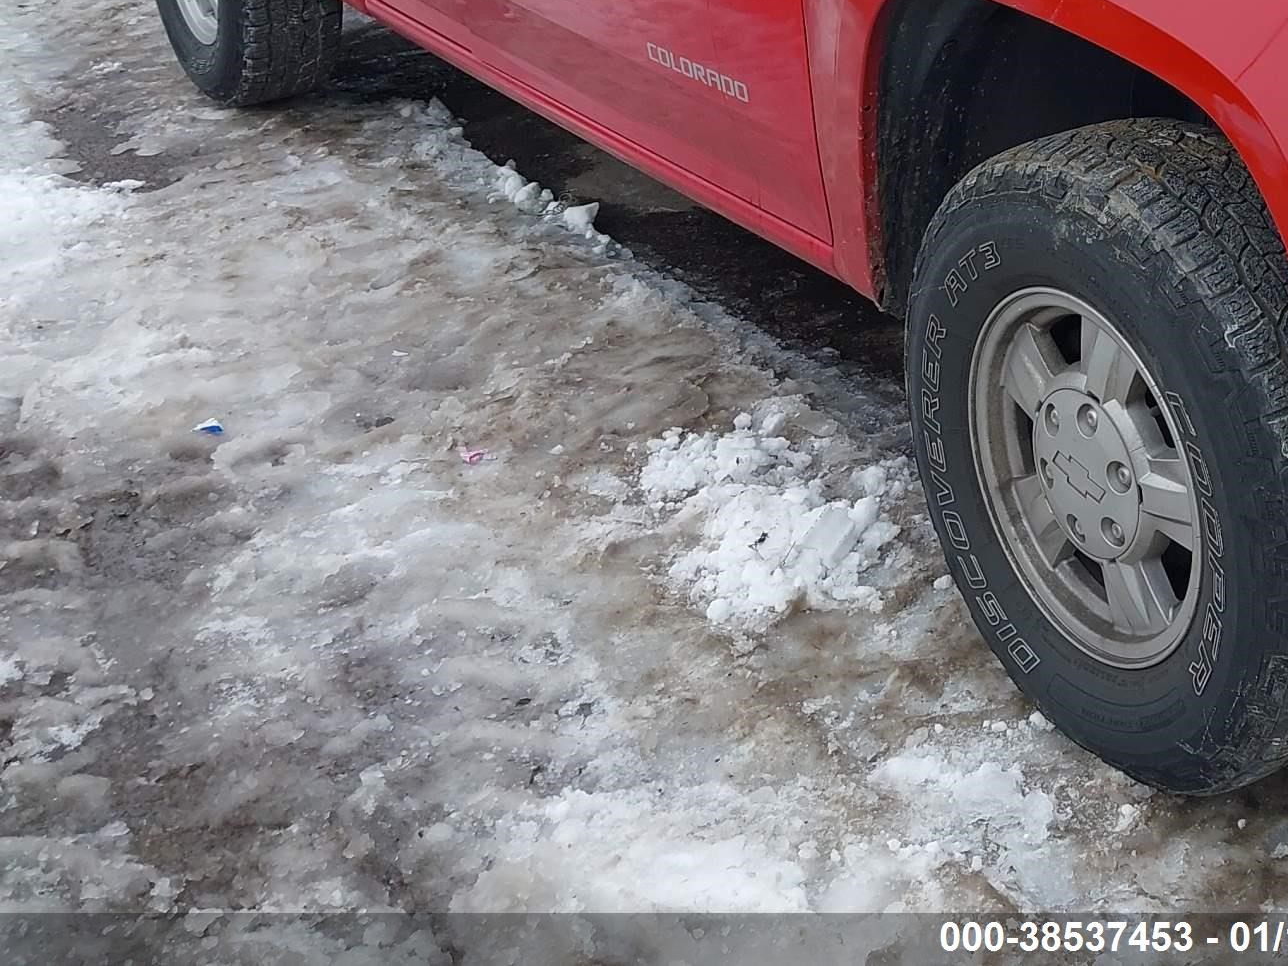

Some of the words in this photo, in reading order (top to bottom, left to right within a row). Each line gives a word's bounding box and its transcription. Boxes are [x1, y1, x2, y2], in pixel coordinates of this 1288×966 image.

[646, 41, 749, 103] COLORADO
[921, 313, 1040, 674] DISCOVERER
[1166, 391, 1226, 697] COOPER
